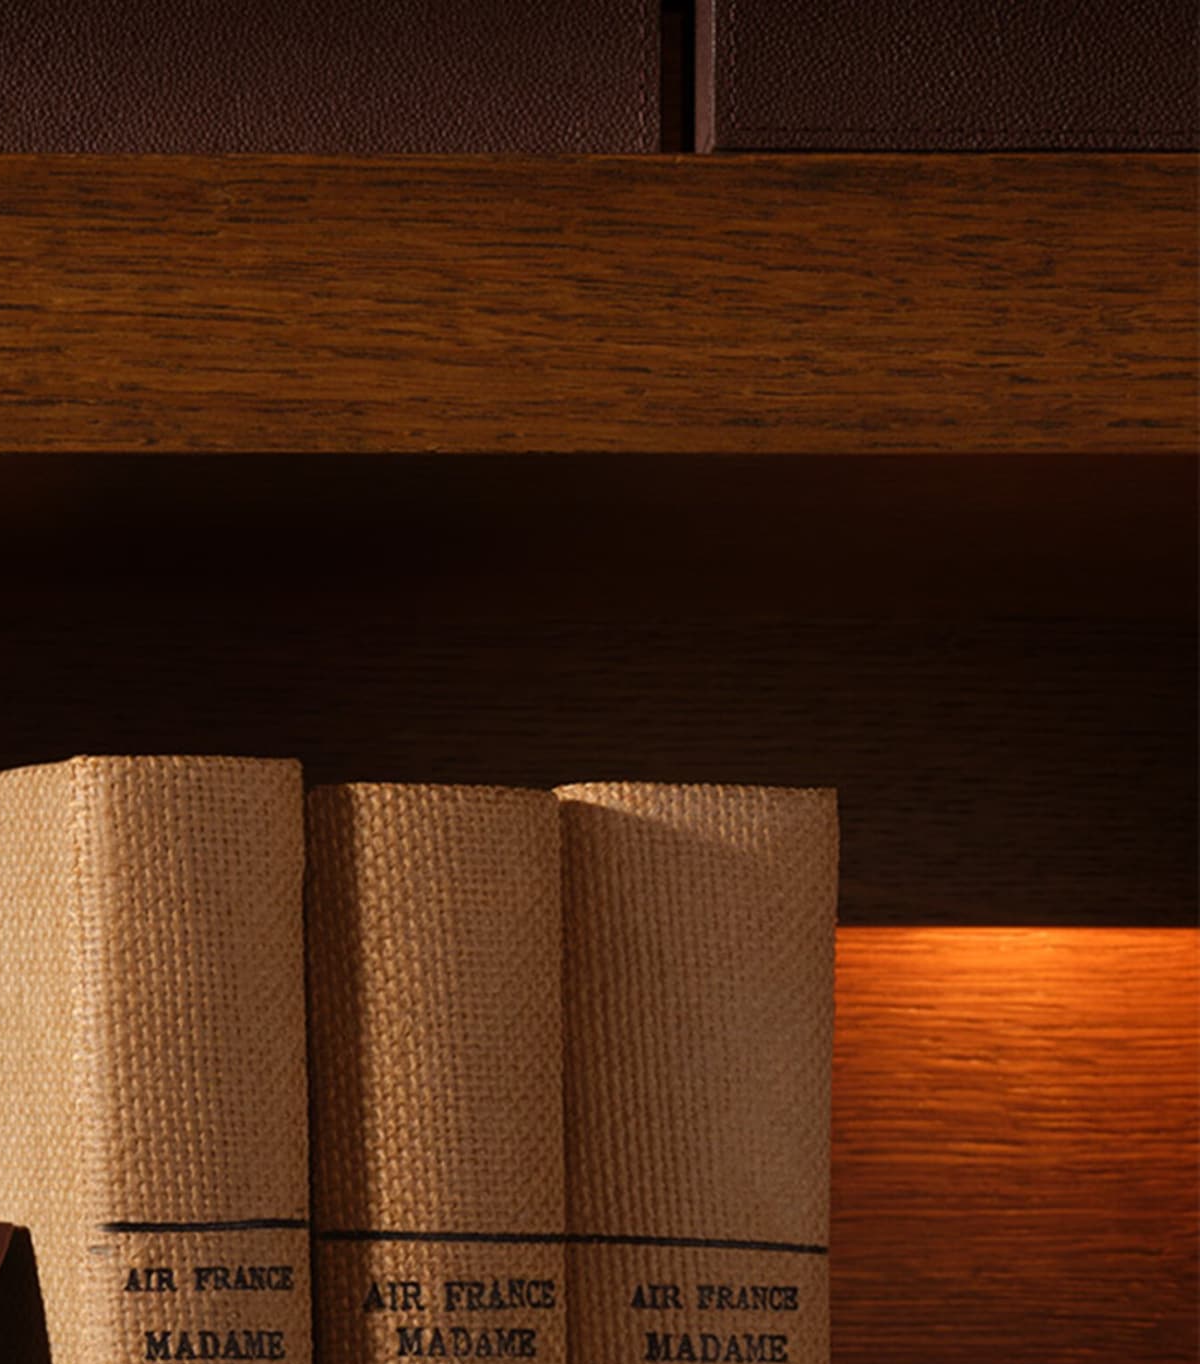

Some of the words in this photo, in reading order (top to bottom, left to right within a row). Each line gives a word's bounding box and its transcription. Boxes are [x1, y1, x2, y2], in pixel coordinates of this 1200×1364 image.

[124, 1267, 178, 1292] AIR
[194, 1265, 294, 1291] FRANCE
[363, 1281, 426, 1313] AIR
[443, 1279, 556, 1311] FRANCE
[630, 1284, 683, 1310] AIR
[696, 1285, 799, 1311] FRANCE
[144, 1330, 286, 1361] MADAME
[396, 1326, 537, 1358] MADAME
[644, 1331, 789, 1363] MADAME
